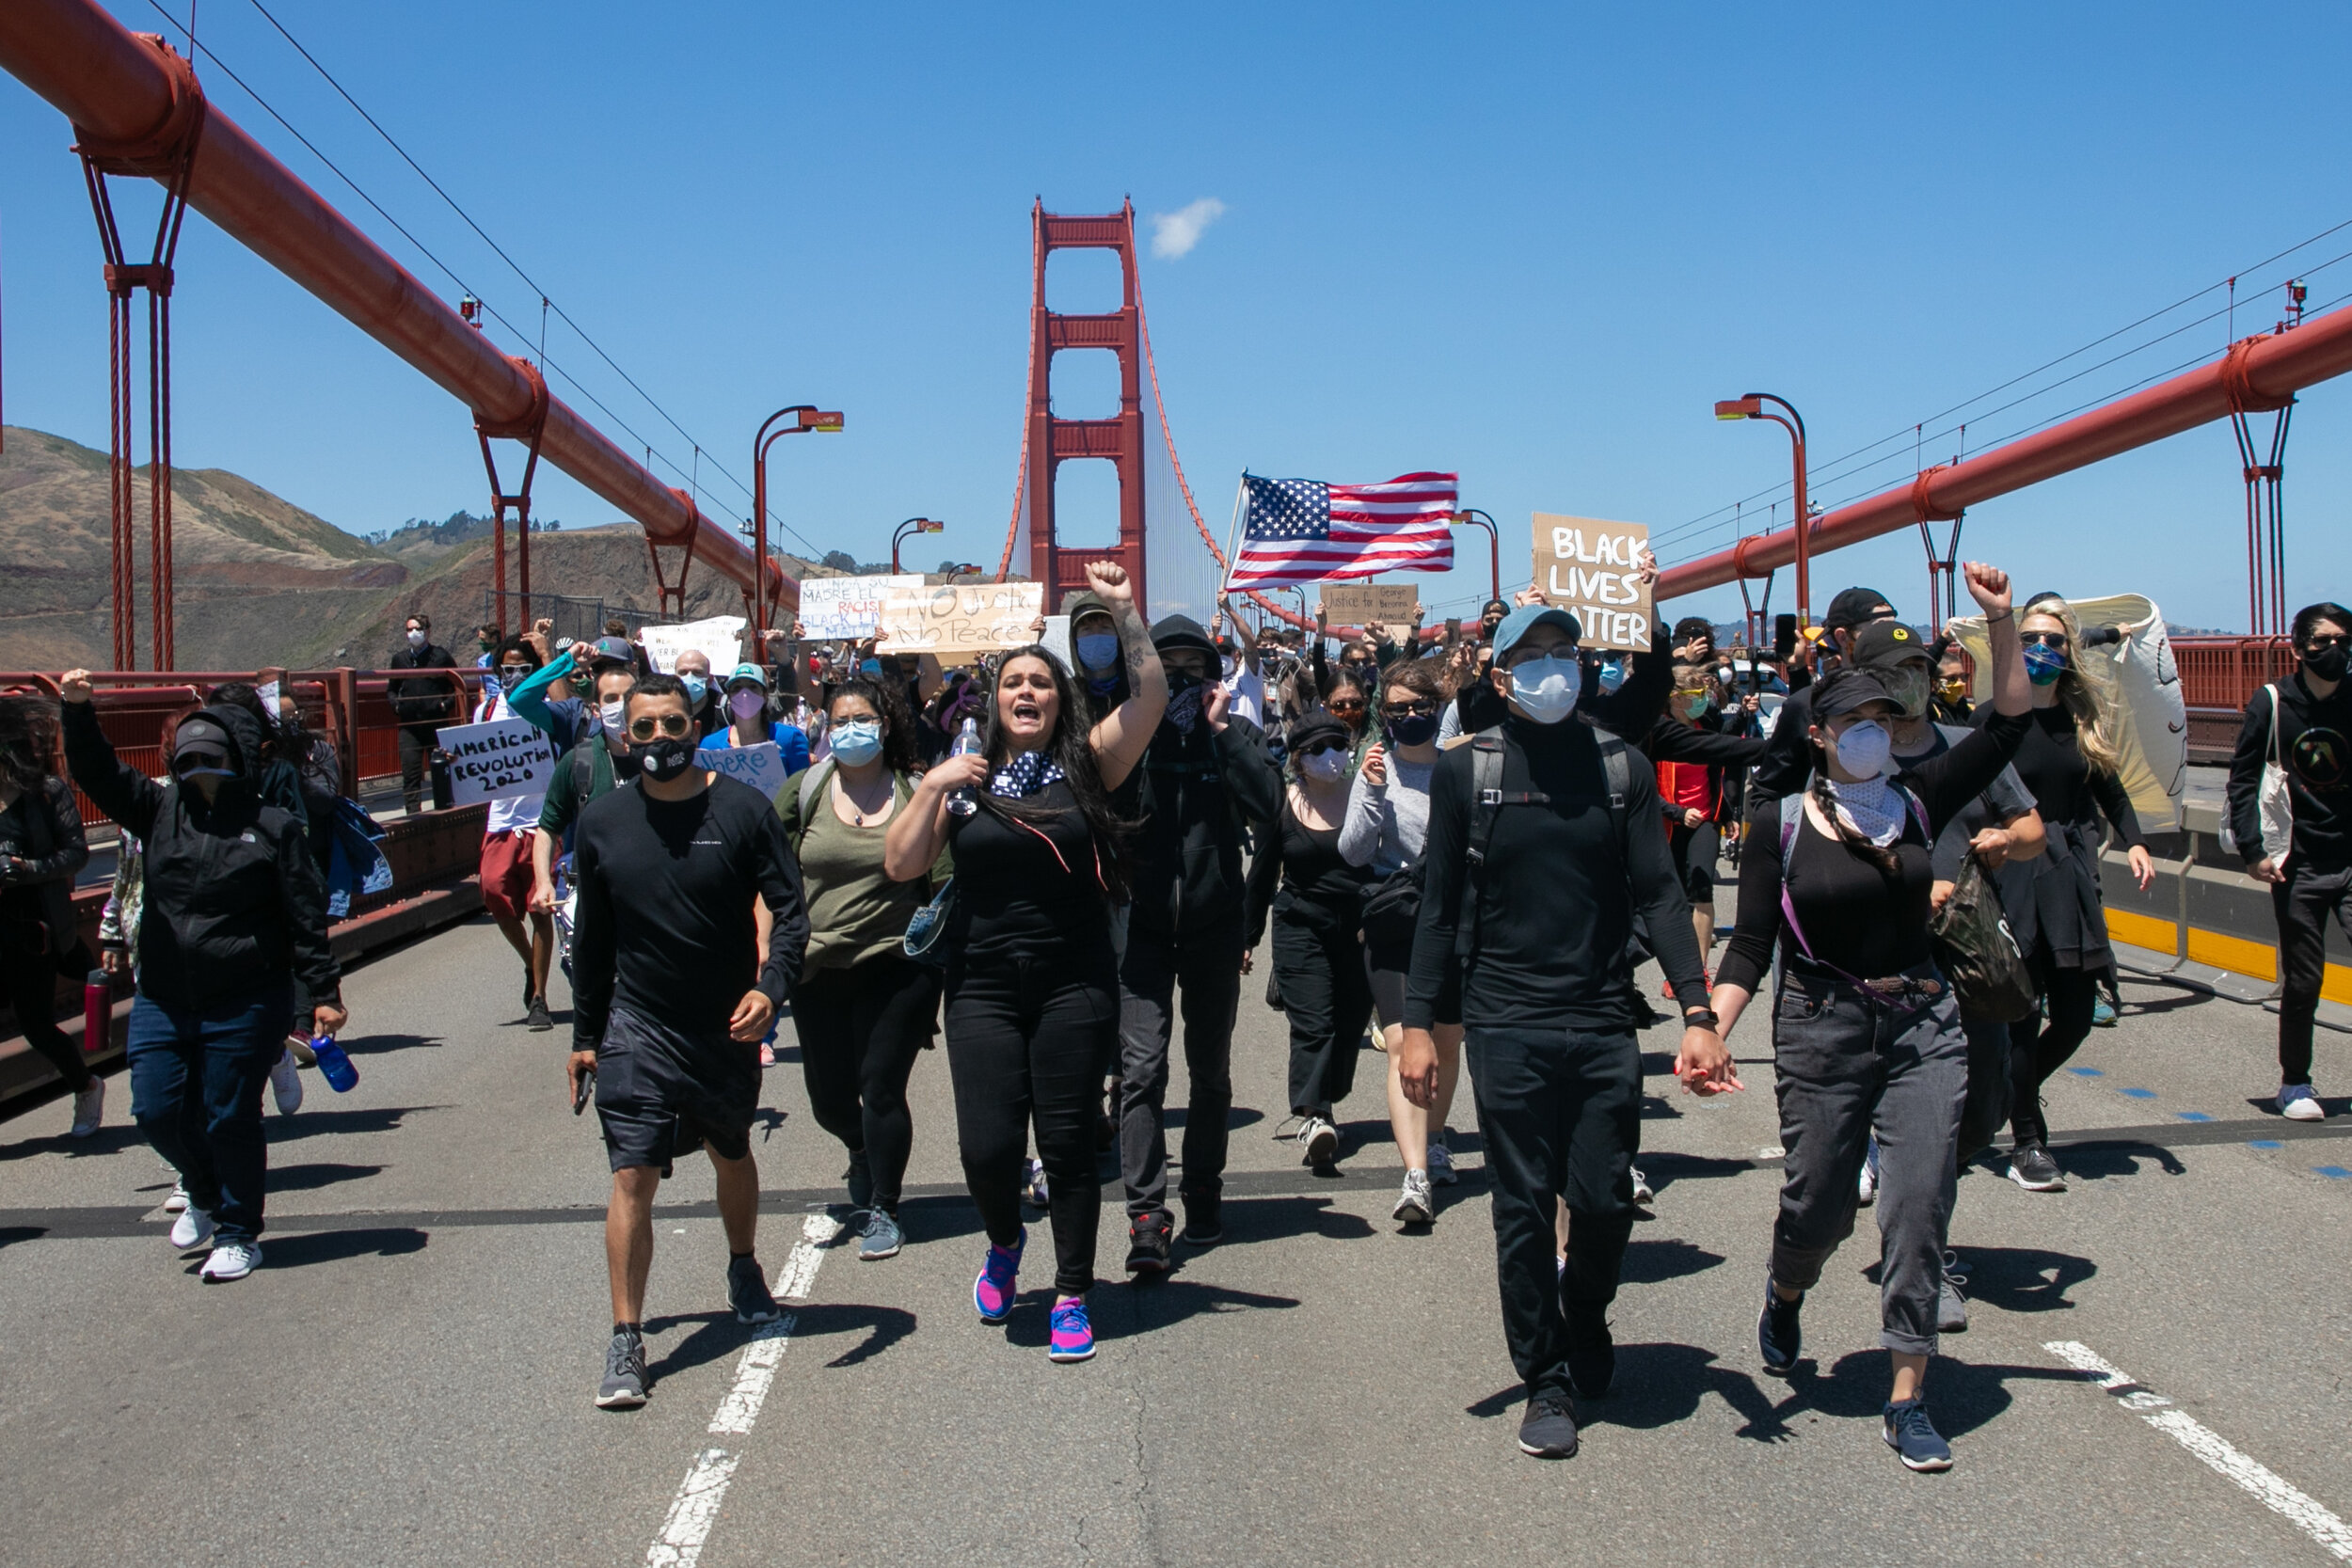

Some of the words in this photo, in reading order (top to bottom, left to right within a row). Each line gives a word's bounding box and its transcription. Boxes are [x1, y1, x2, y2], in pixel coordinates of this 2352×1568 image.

[1551, 526, 1648, 570] BLACK
[803, 589, 851, 603] MADRE
[859, 589, 878, 600] EL
[1549, 564, 1642, 605] LIVES
[837, 601, 879, 621] RACIS
[906, 587, 958, 622] NO
[1325, 592, 1359, 610] Justice
[800, 611, 854, 628] BLACK
[1556, 604, 1651, 647] ATTER
[478, 768, 534, 792] 2020
